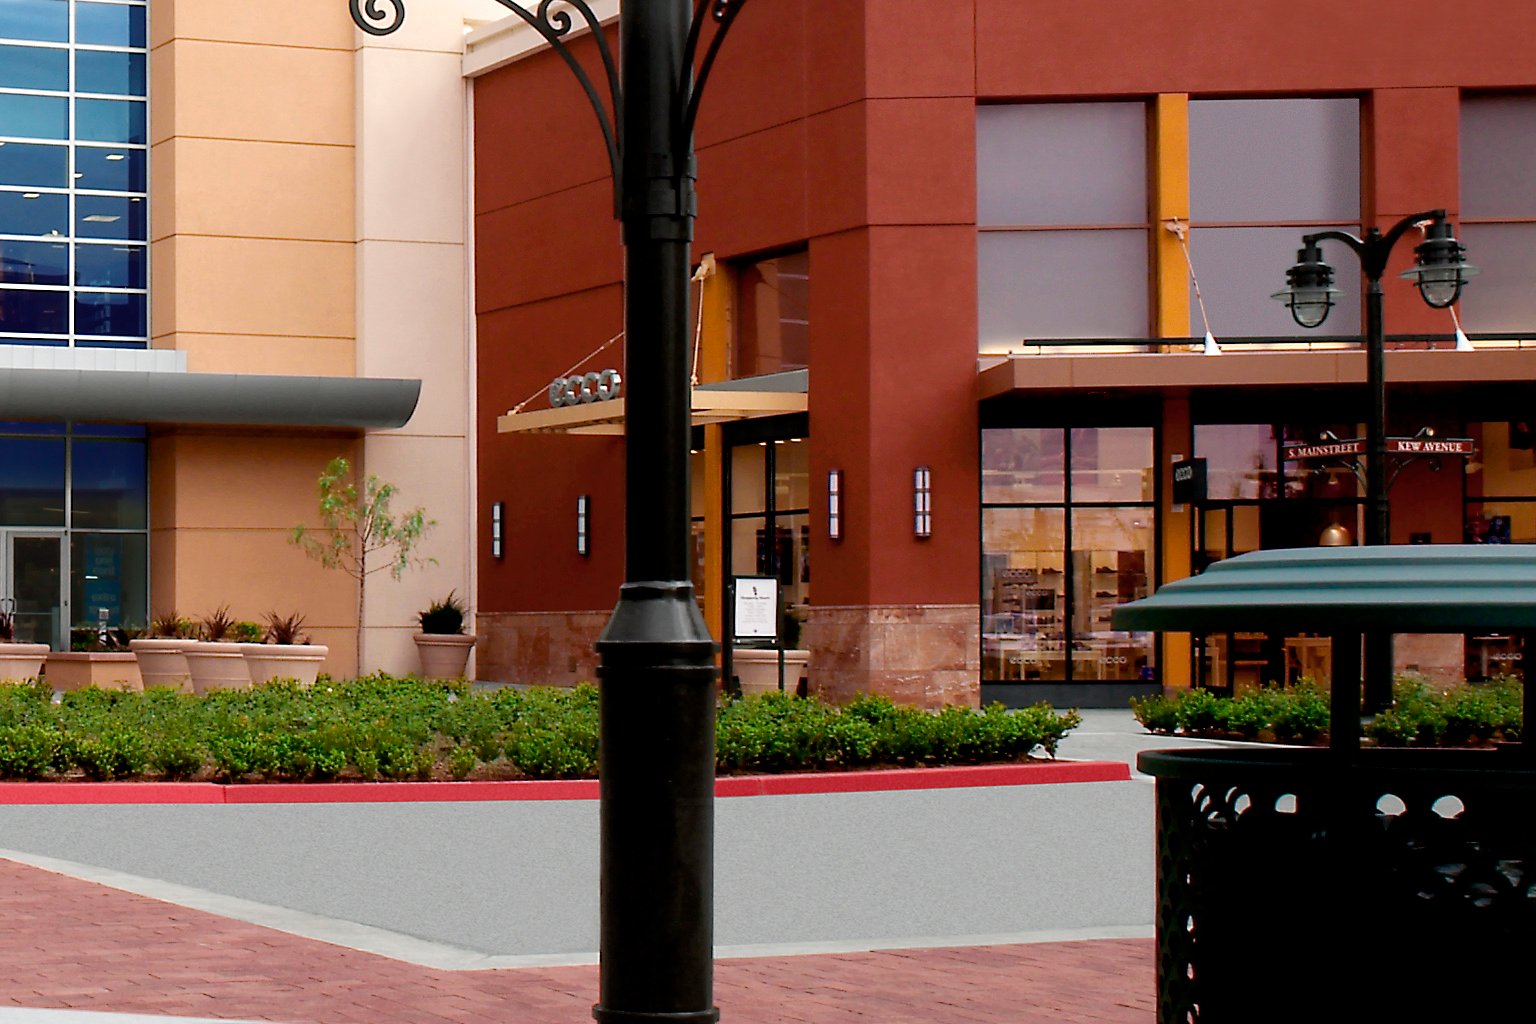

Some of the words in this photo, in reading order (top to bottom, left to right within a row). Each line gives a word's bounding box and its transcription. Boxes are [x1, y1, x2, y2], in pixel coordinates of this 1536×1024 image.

[549, 368, 622, 408] ecco
[1298, 442, 1360, 457] MAINSTREET
[1397, 441, 1421, 452] KEW
[1422, 441, 1463, 453] AVENUE
